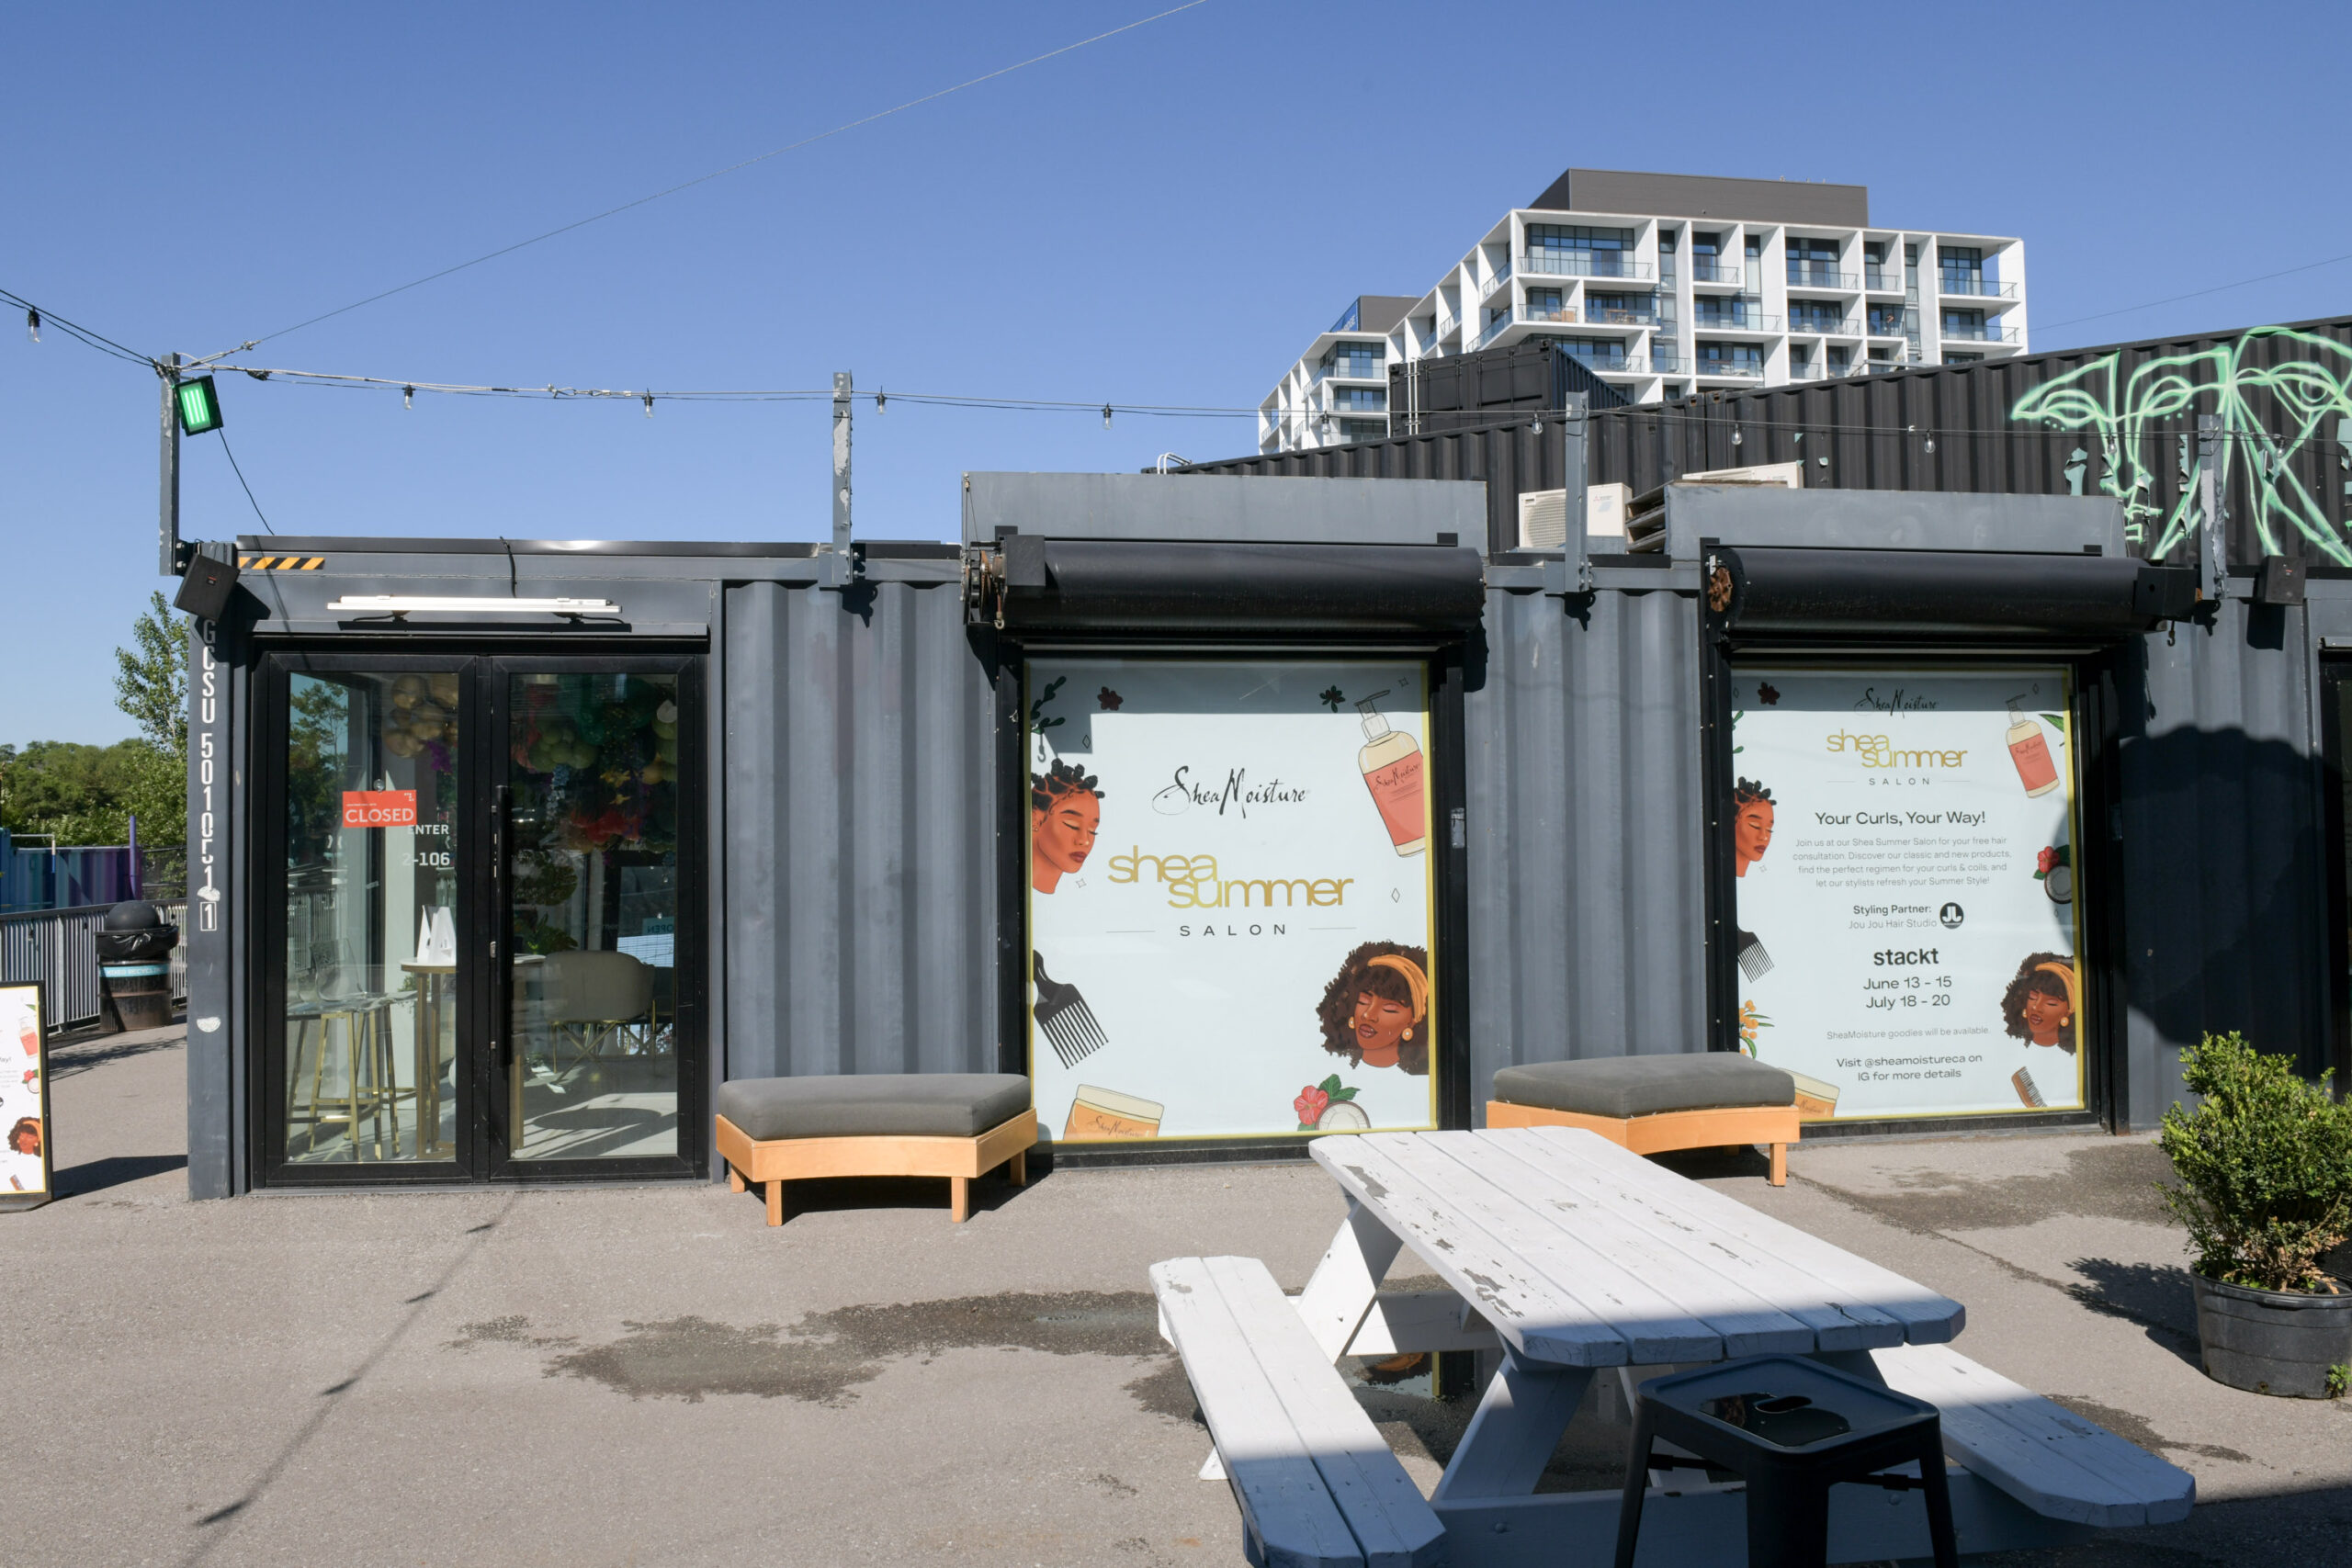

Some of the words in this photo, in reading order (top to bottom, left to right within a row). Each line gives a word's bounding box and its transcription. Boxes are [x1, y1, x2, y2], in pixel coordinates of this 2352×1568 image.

[201, 619, 216, 724] GCSU
[1826, 728, 1890, 752] shea
[1861, 750, 1968, 768] summer
[1869, 778, 1930, 786] SALON
[345, 808, 414, 823] CLOSED
[1815, 812, 1851, 825] Your
[1856, 812, 1904, 827] Curls,
[1905, 811, 1942, 824] Your
[1946, 810, 1985, 827] Way!
[408, 824, 449, 835] ENTER
[1795, 839, 1813, 847] Join
[1852, 838, 1874, 846] Shea
[1875, 838, 1911, 846] Summer
[1913, 837, 1937, 845] Salon
[1939, 837, 1950, 845] for
[1951, 838, 1970, 847] your
[1973, 836, 1990, 845] free
[402, 852, 450, 866] 2-106
[1848, 852, 1885, 860] Discover
[1903, 851, 1933, 859] classic
[1934, 851, 1950, 859] and
[1108, 845, 1218, 884] shea
[1798, 865, 1815, 874] find
[1816, 865, 1831, 874] the
[1832, 865, 1864, 875] perfect
[1865, 864, 1901, 874] regimen
[1902, 864, 1915, 873] for
[1917, 865, 1935, 874] your
[1937, 863, 1957, 872] curls
[1959, 863, 1965, 872] &
[1991, 863, 2007, 872] and
[1815, 878, 1827, 887] let
[1845, 878, 1875, 888] stylists
[1876, 877, 1906, 886] refresh
[1907, 879, 1927, 887] your
[1928, 876, 1964, 886] Summer
[1966, 875, 1990, 886] Style!
[1168, 877, 1354, 908] summer
[1853, 904, 1889, 917] Styling
[1891, 905, 1932, 914] Partner:
[1180, 923, 1286, 937] SALON
[1849, 920, 1866, 930] Jou
[1867, 919, 1883, 930] Jou
[1885, 919, 1904, 928] Hair
[1905, 919, 1938, 928] Studio
[1873, 948, 1939, 965] stackt
[1863, 977, 1900, 990] June
[1904, 976, 1920, 989] 13
[1935, 976, 1952, 987] 15
[1866, 996, 1895, 1010] July
[1900, 995, 1917, 1007] 18
[1932, 994, 1951, 1006] 20
[1826, 1030, 1886, 1040] SheaMoisture
[1888, 1029, 1924, 1039] goodies
[1925, 1028, 1939, 1037] will
[1939, 1028, 1951, 1036] be
[1837, 1057, 1862, 1067] Visit
[1864, 1055, 1966, 1068] @sheamoistureca
[1858, 1072, 1870, 1081] IG
[1872, 1071, 1890, 1080] for
[1893, 1072, 1921, 1080] more
[1924, 1068, 1962, 1078] details
